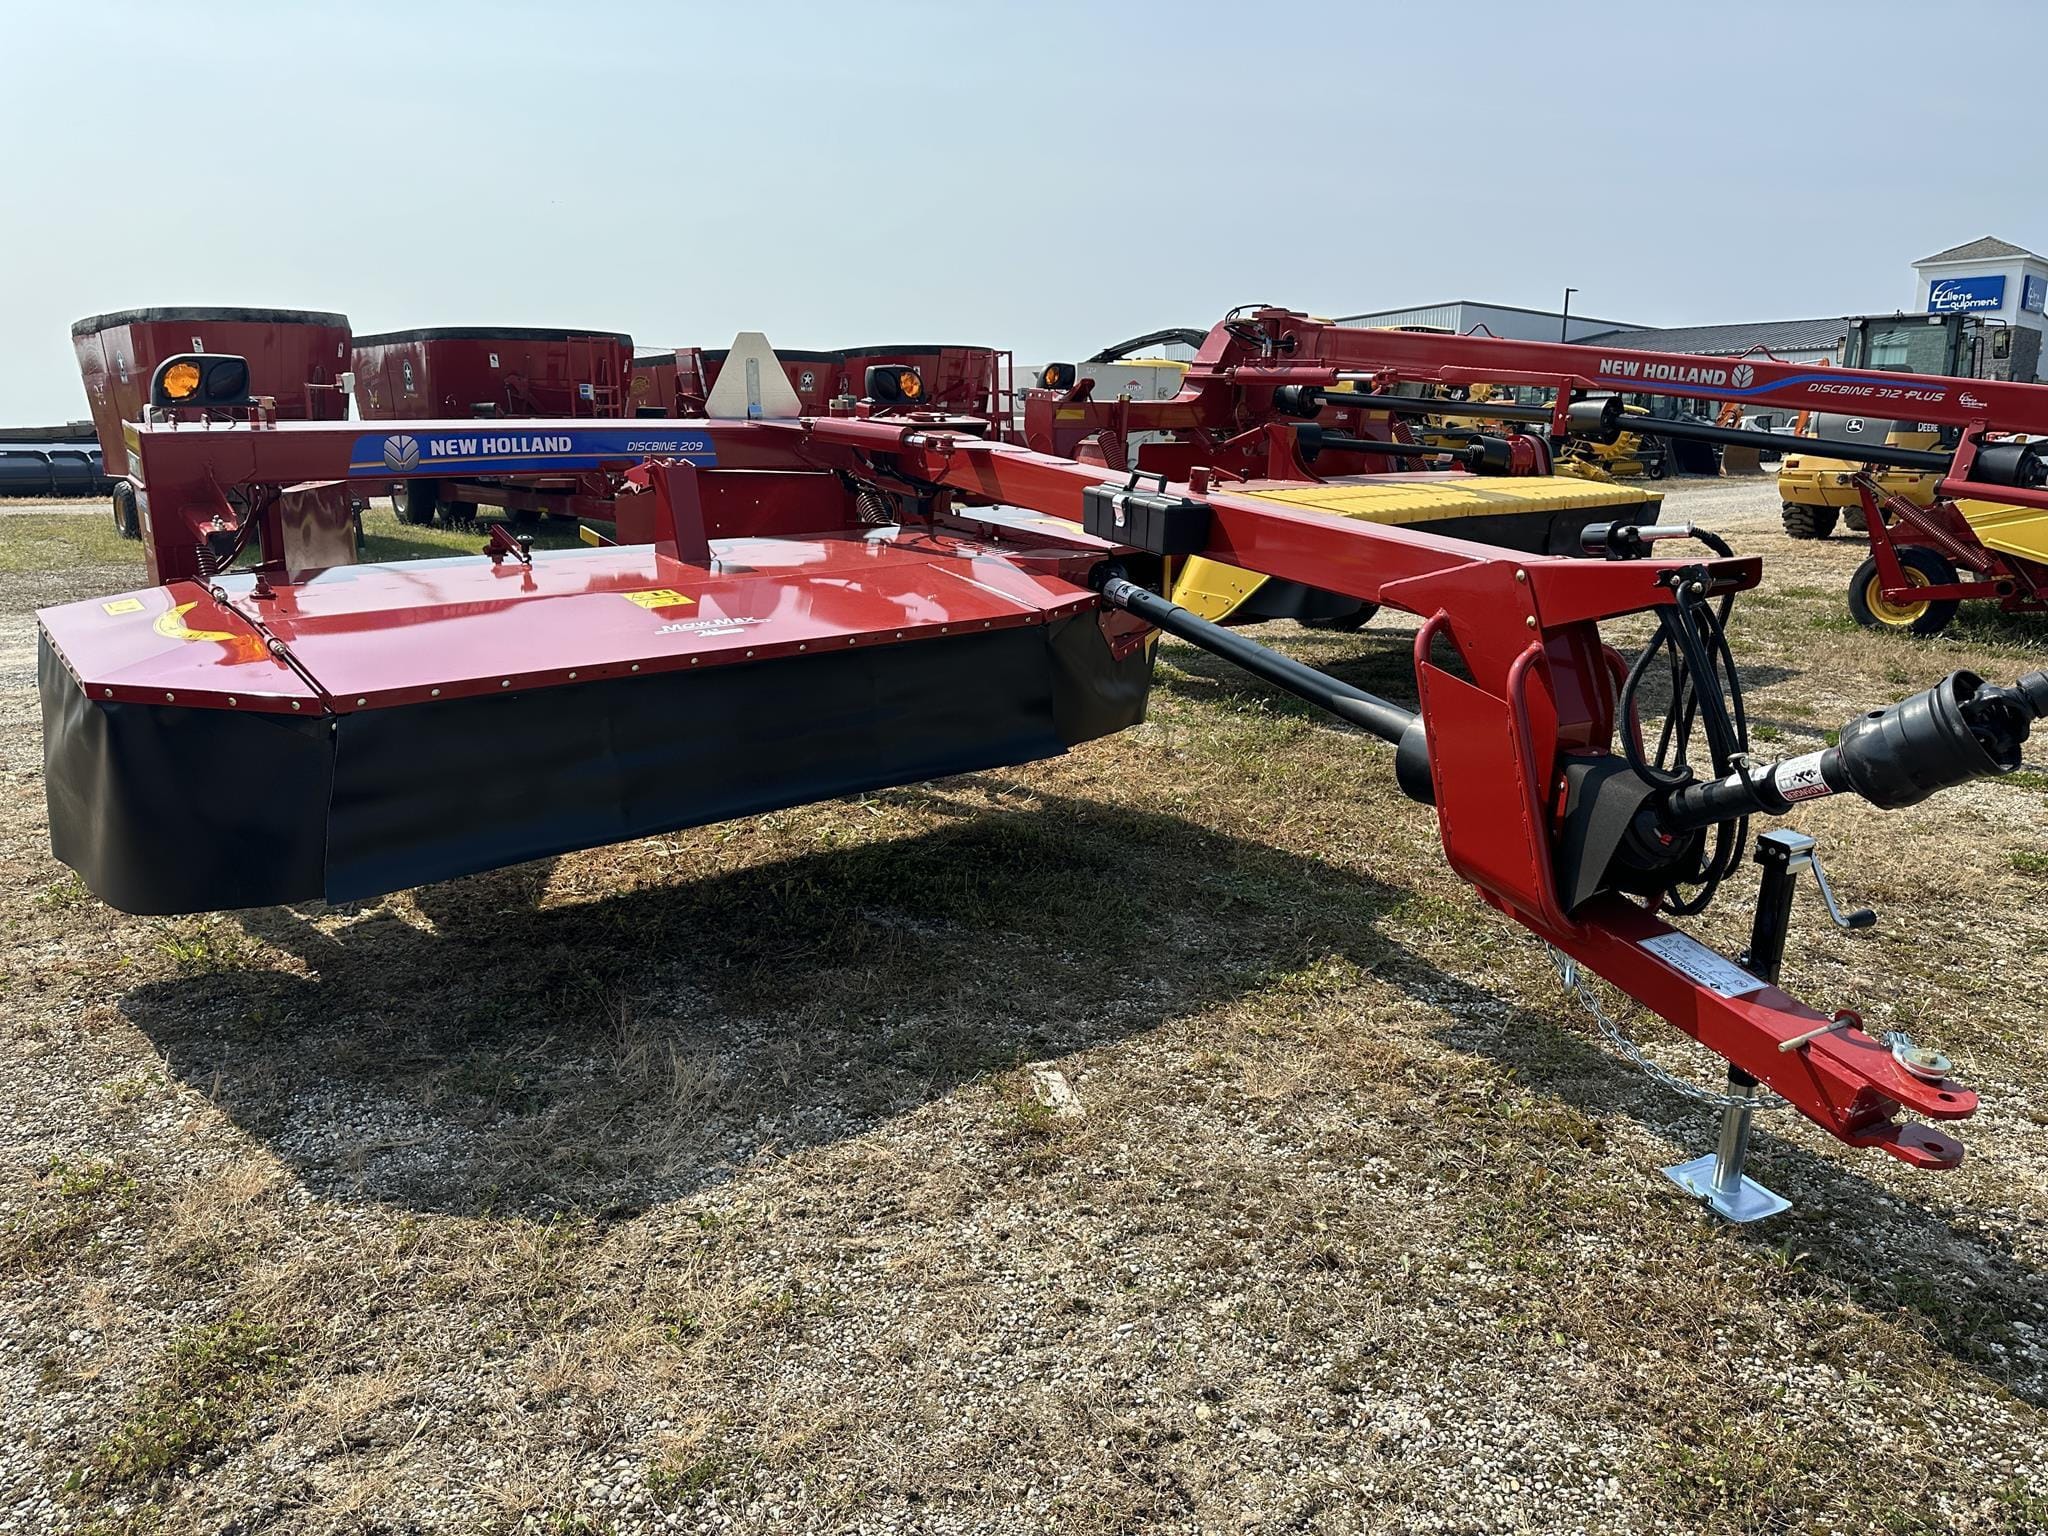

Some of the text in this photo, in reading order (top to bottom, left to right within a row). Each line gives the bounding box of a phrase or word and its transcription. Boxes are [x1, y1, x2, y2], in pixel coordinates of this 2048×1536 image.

[1931, 280, 1973, 302] Ellens
[1599, 358, 1727, 386] NEW HOLLAND
[1807, 383, 1875, 397] DISCBINE
[1875, 388, 1902, 399] 312
[1917, 422, 1939, 432] DEERE
[430, 437, 572, 456] NEW HOLLAND
[627, 441, 704, 452] DISCBINE 209
[1784, 785, 1817, 800] DANGER
[1656, 949, 1708, 981] IMPORTANT
